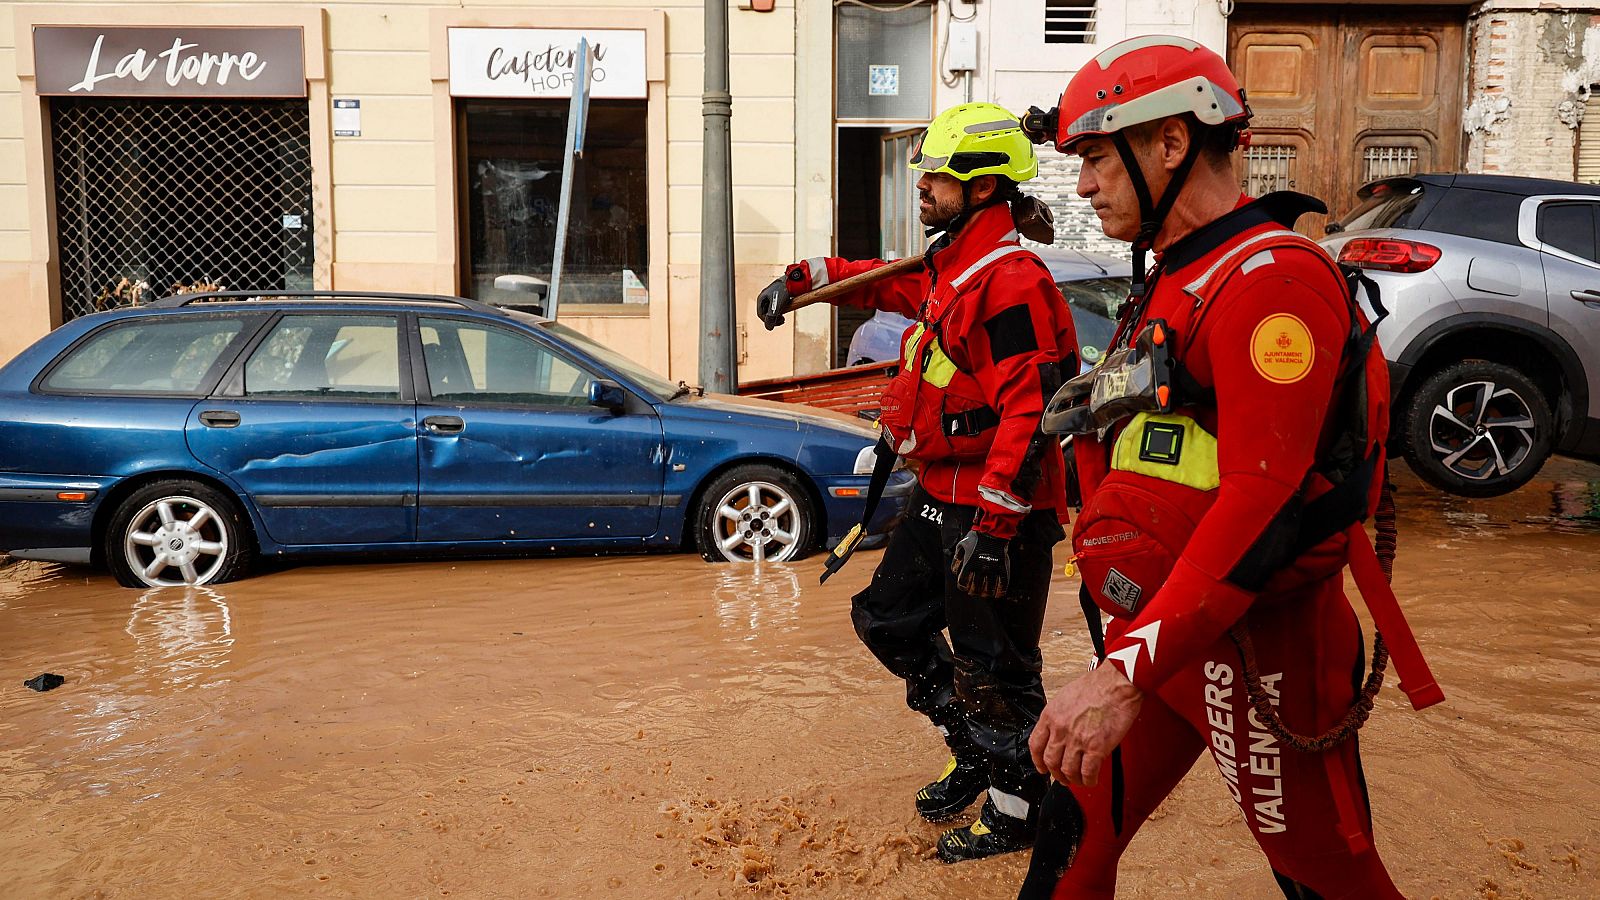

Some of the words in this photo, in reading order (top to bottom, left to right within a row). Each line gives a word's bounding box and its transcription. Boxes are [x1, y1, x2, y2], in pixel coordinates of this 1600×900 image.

[68, 34, 158, 93] La
[158, 37, 267, 87] torre
[486, 43, 608, 83] Cafetera
[531, 67, 606, 92] HORO
[920, 504, 944, 525] 224
[1204, 660, 1249, 823] OMBERS
